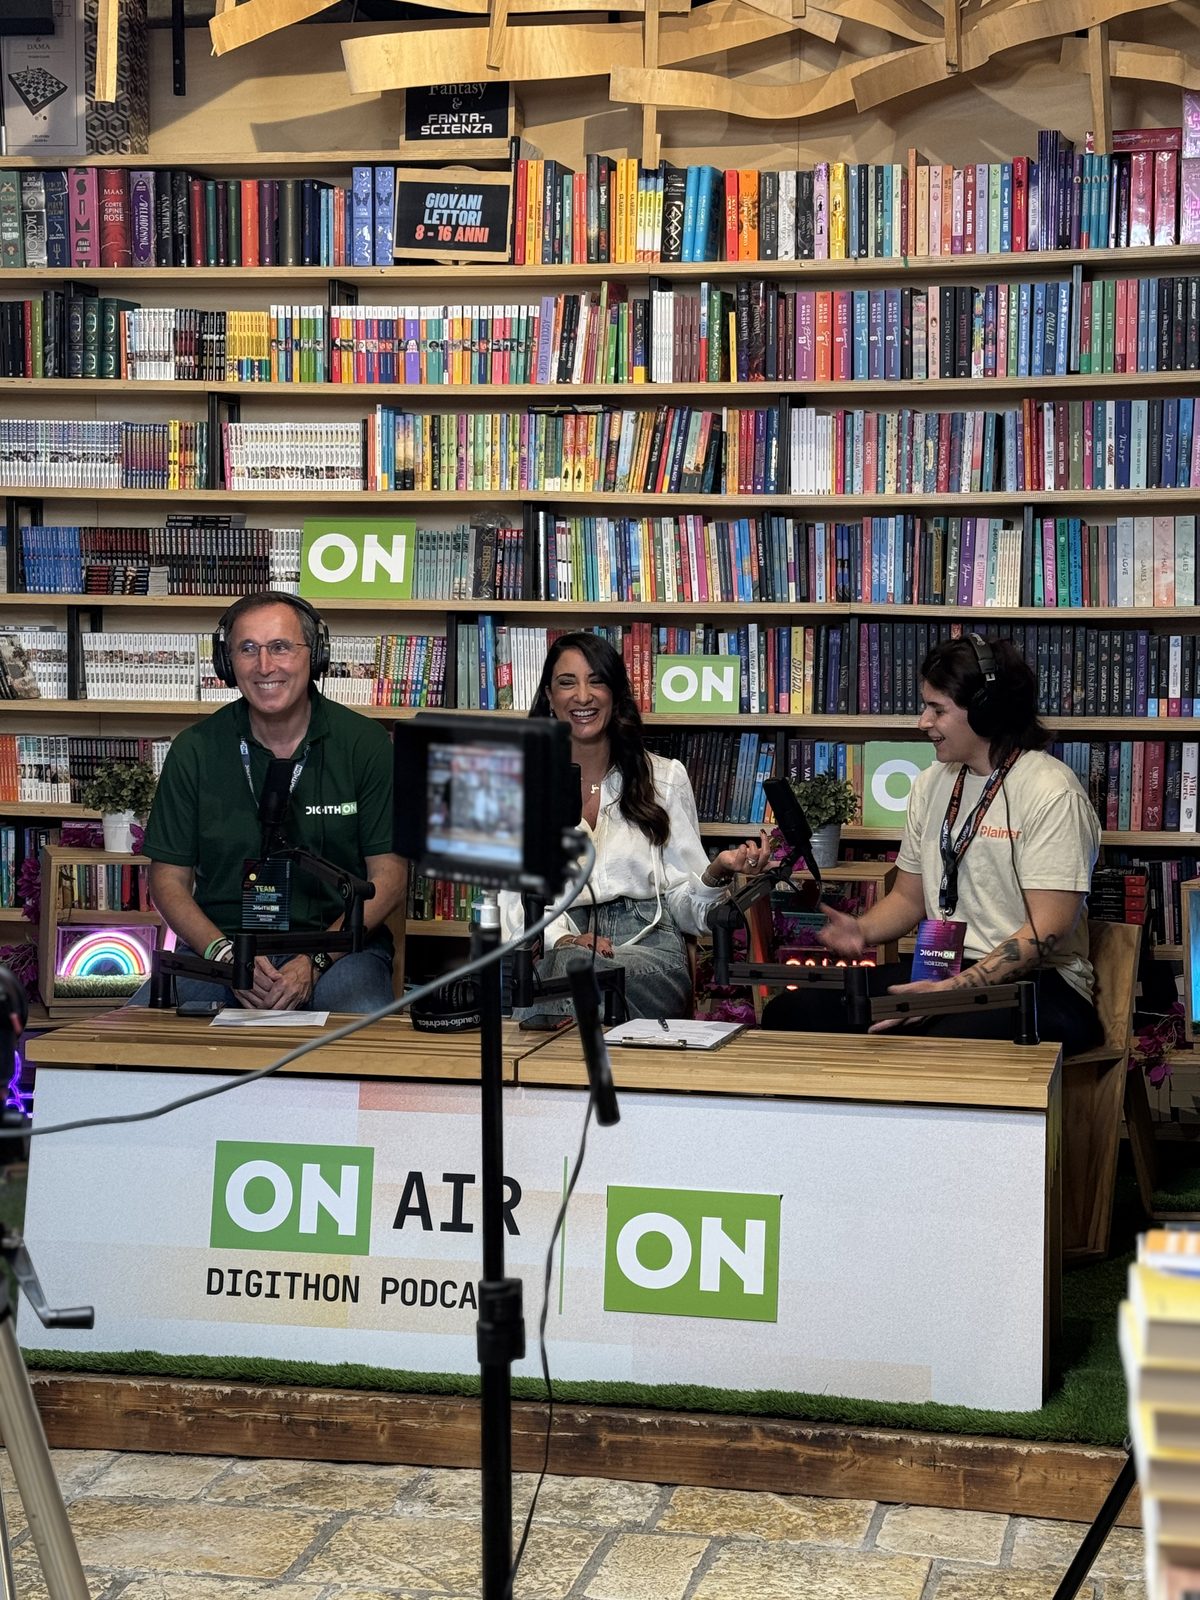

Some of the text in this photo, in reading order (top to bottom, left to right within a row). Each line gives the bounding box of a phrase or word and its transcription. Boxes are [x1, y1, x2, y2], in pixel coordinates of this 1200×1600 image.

[428, 83, 487, 100] Fantasy
[452, 97, 463, 109] &
[428, 113, 485, 125] FANTA-
[420, 123, 493, 136] SCIENZA
[103, 188, 124, 196] MAAS
[425, 192, 483, 211] GIOVANI
[104, 214, 125, 222] ROSE
[423, 208, 483, 227] LETTORI
[415, 224, 425, 241] 8
[437, 225, 452, 242] 16
[454, 228, 490, 244] ANNI
[1046, 311, 1056, 345] COLLIDE
[1083, 315, 1091, 330] AMY
[307, 532, 407, 584] ON
[481, 545, 491, 582] BERSERK
[1182, 556, 1190, 572] LIES
[660, 665, 735, 702] ON
[792, 657, 802, 695] SPIRAL
[870, 758, 922, 812] O
[1109, 775, 1119, 805] Daylight
[1182, 771, 1191, 801] Hearts
[1189, 775, 1197, 798] Wild
[980, 825, 1023, 840] Plainer
[254, 885, 276, 895] TEAM
[919, 948, 956, 960] DIGITHON
[225, 1160, 523, 1236] ON AIR
[615, 1211, 767, 1296] ON
[206, 1266, 480, 1311] DIGITHON PODCA
